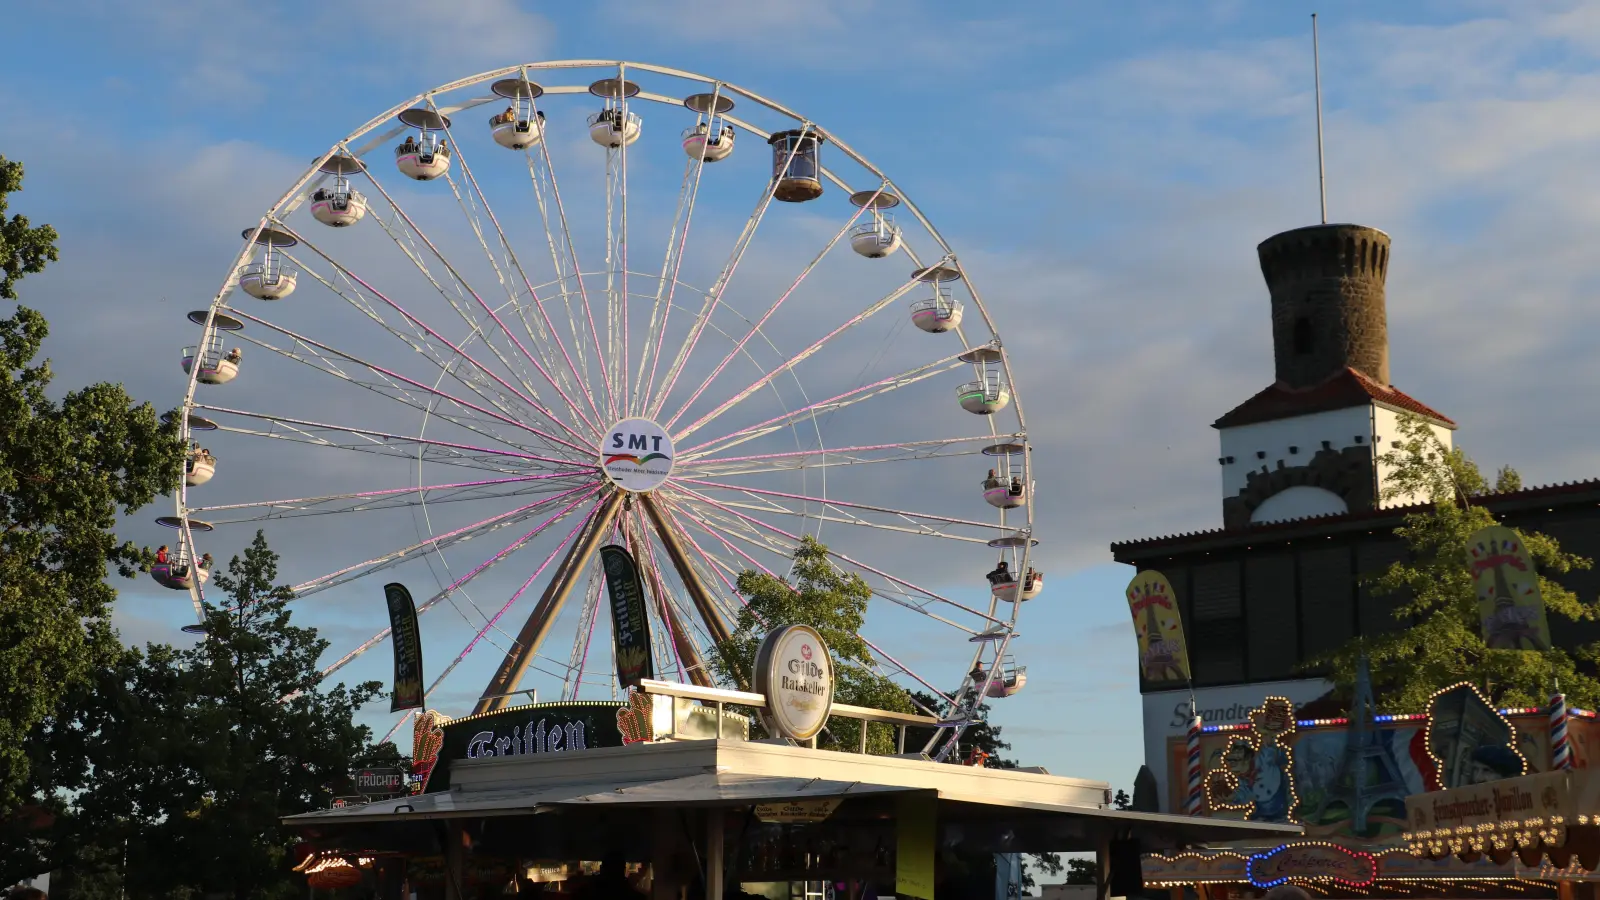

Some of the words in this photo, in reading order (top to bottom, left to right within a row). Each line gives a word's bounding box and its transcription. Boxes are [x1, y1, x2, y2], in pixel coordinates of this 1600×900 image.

[612, 432, 663, 451] SMT
[623, 580, 642, 633] MEISTER
[788, 658, 824, 680] Gilde
[781, 675, 826, 697] Ratskeller
[467, 718, 587, 759] Fritten
[358, 773, 400, 787] FRÜCHTE
